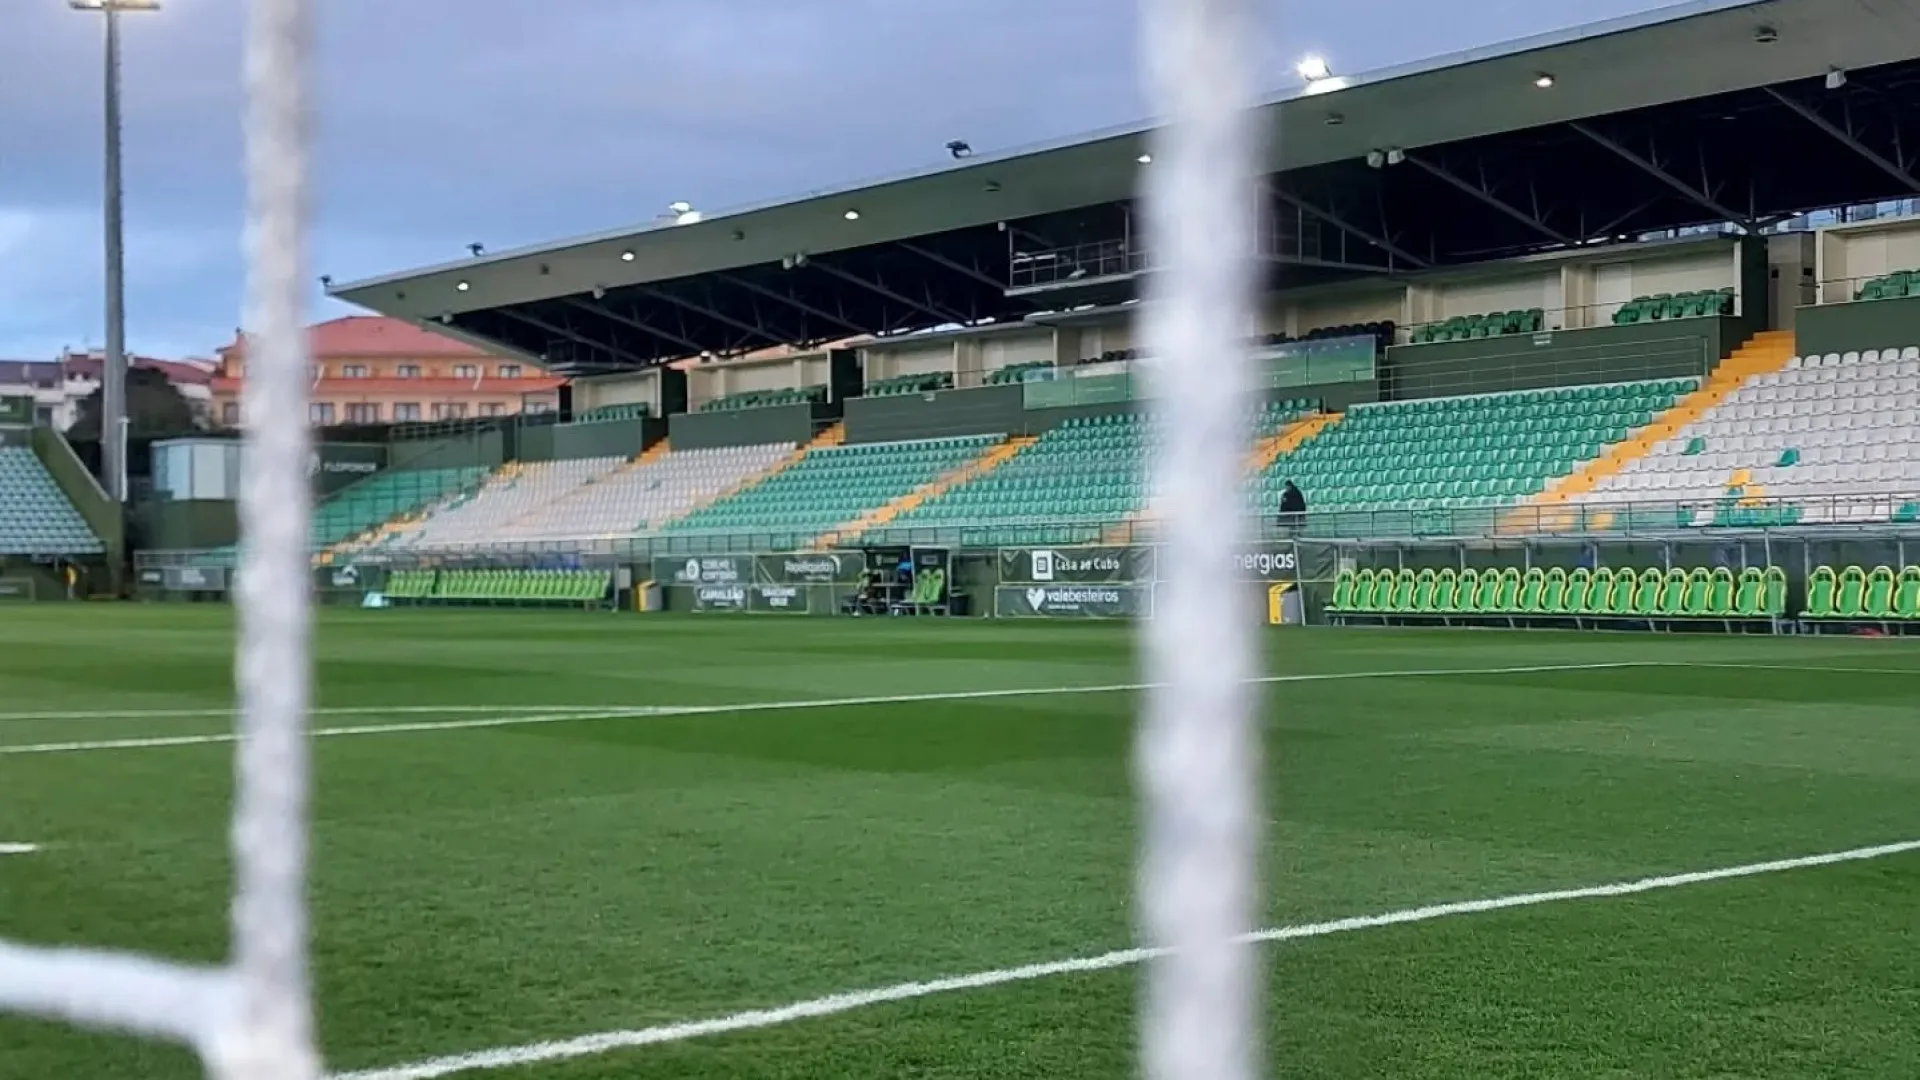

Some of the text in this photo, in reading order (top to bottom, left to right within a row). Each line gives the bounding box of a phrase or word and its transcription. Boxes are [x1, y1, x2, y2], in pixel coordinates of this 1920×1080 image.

[1055, 558, 1077, 570] Casa
[1094, 557, 1120, 570] Cubo
[1232, 553, 1294, 574] nergias
[1047, 588, 1119, 602] valebesteiros
